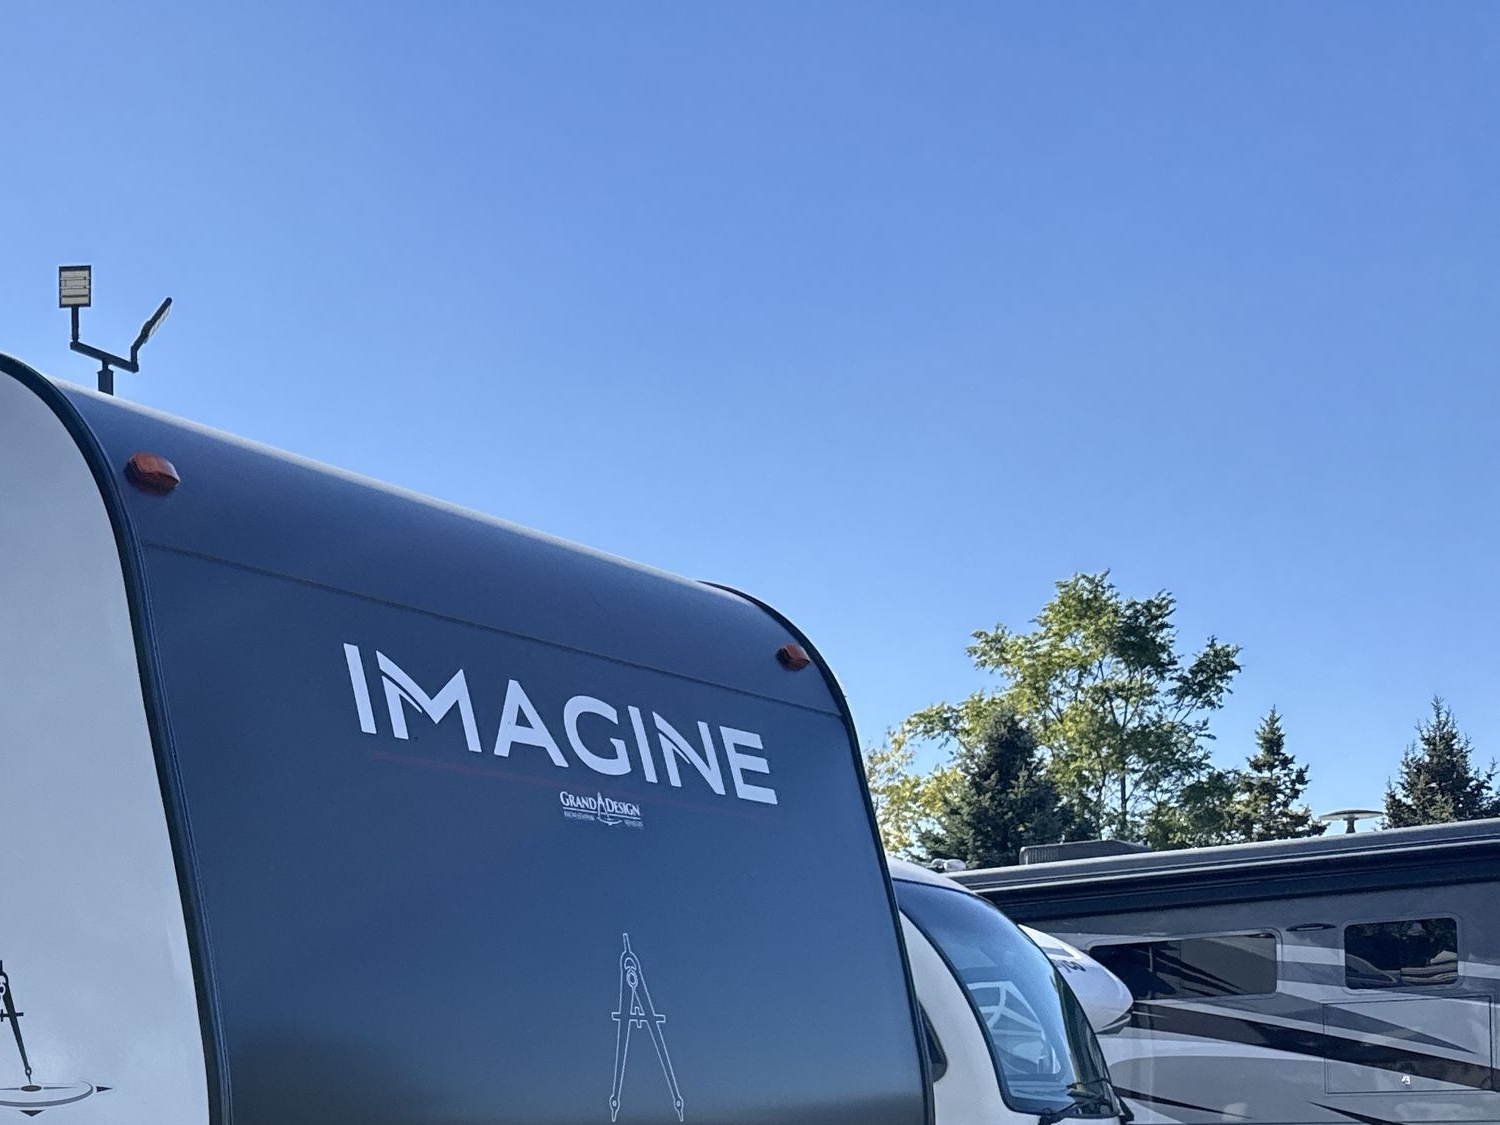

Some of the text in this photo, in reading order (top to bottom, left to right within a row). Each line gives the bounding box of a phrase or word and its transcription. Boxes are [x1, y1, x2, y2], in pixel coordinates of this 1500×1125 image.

[343, 642, 778, 805] IMAGINE
[559, 791, 597, 810] GRAND
[605, 797, 641, 816] DESIGN
